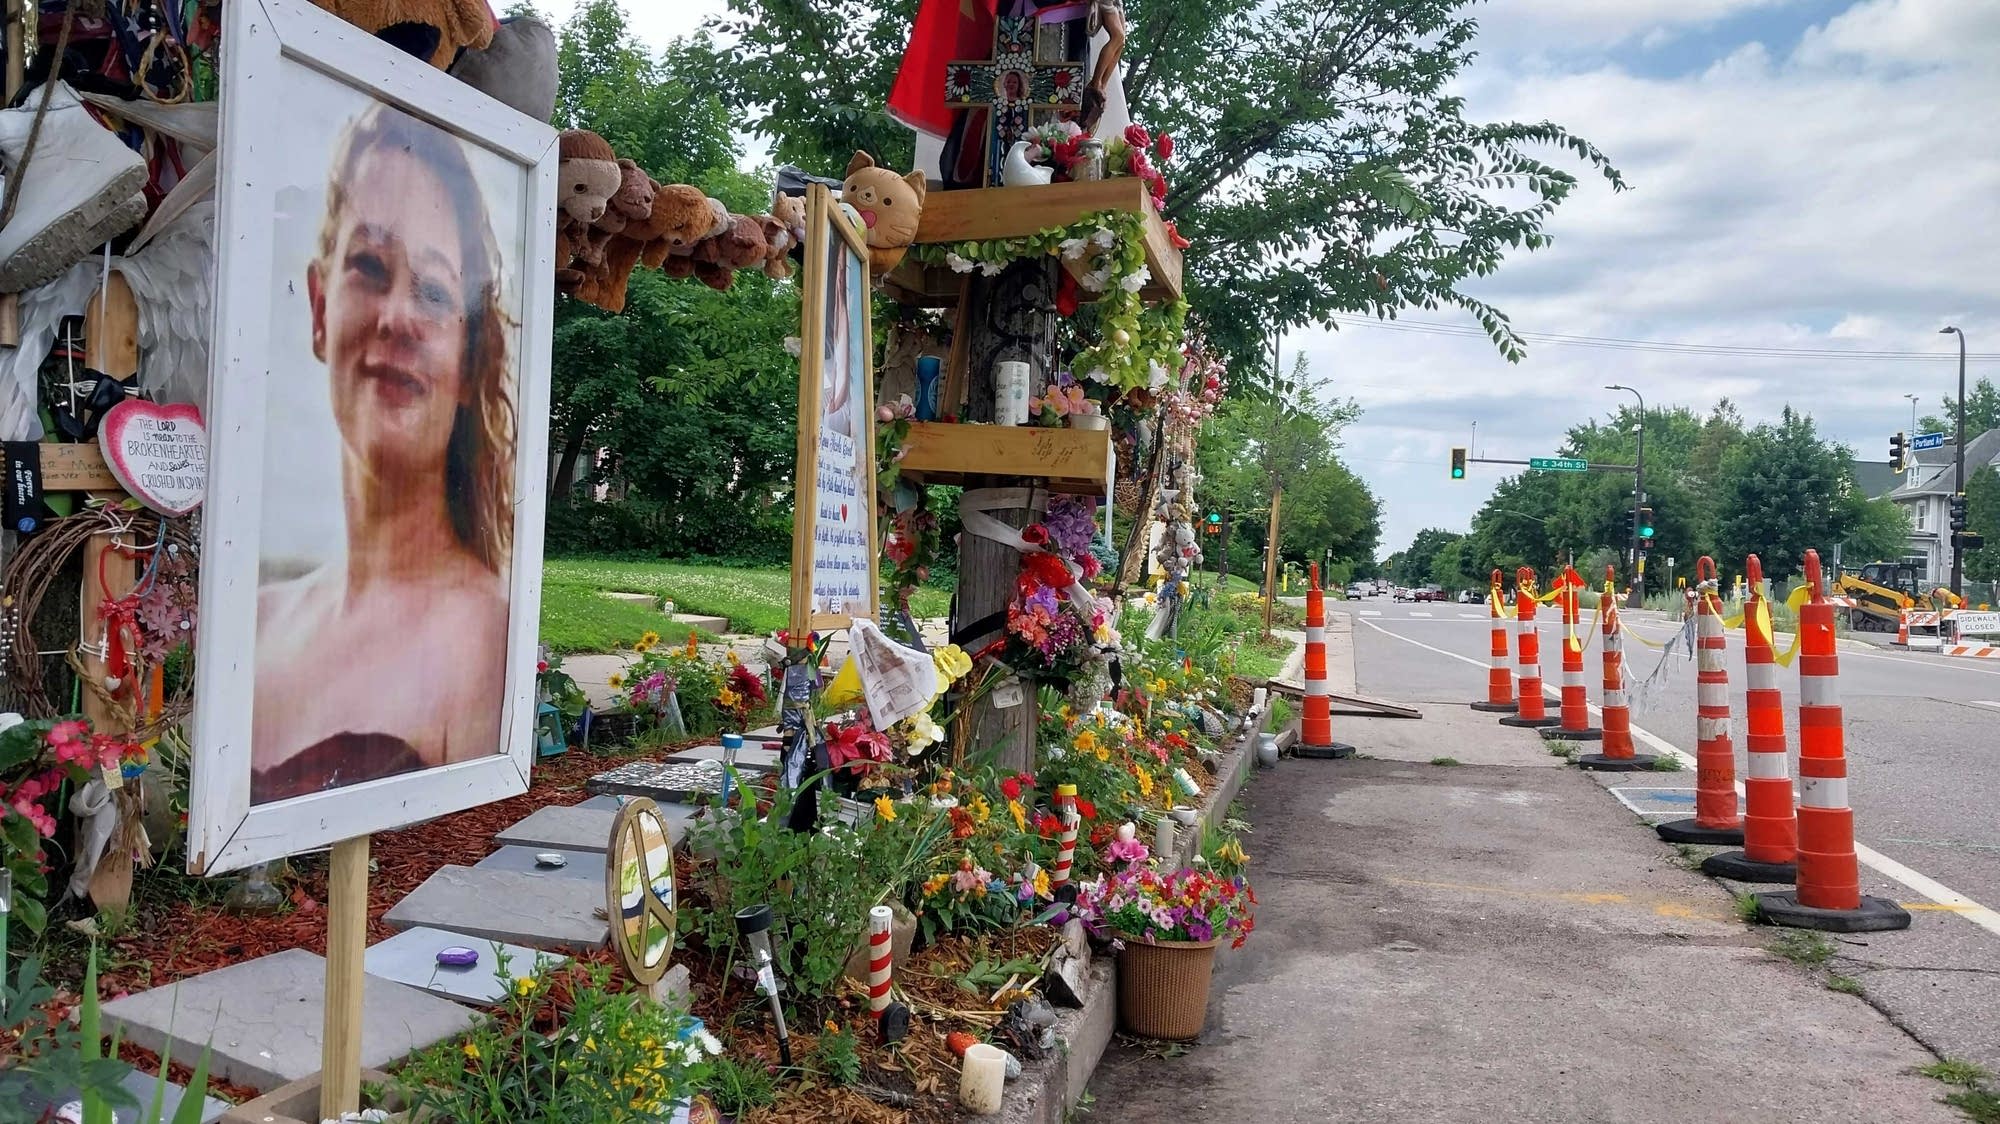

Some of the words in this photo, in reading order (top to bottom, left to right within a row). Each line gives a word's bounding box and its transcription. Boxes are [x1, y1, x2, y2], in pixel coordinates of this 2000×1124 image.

[137, 418, 153, 430] THE
[156, 419, 176, 432] LORD
[143, 432, 150, 441] IS
[174, 433, 183, 443] TO
[183, 434, 198, 443] THE
[1915, 436, 1935, 448] Portland
[148, 461, 168, 471] AND
[189, 463, 206, 473] THE
[1551, 460, 1573, 468] 34th
[1575, 461, 1586, 469] St
[24, 469, 34, 498] Forever
[141, 473, 175, 489] CRUSHED
[176, 476, 186, 489] IN
[17, 482, 27, 505] hearts
[1960, 615, 1998, 623] SIDEWALK
